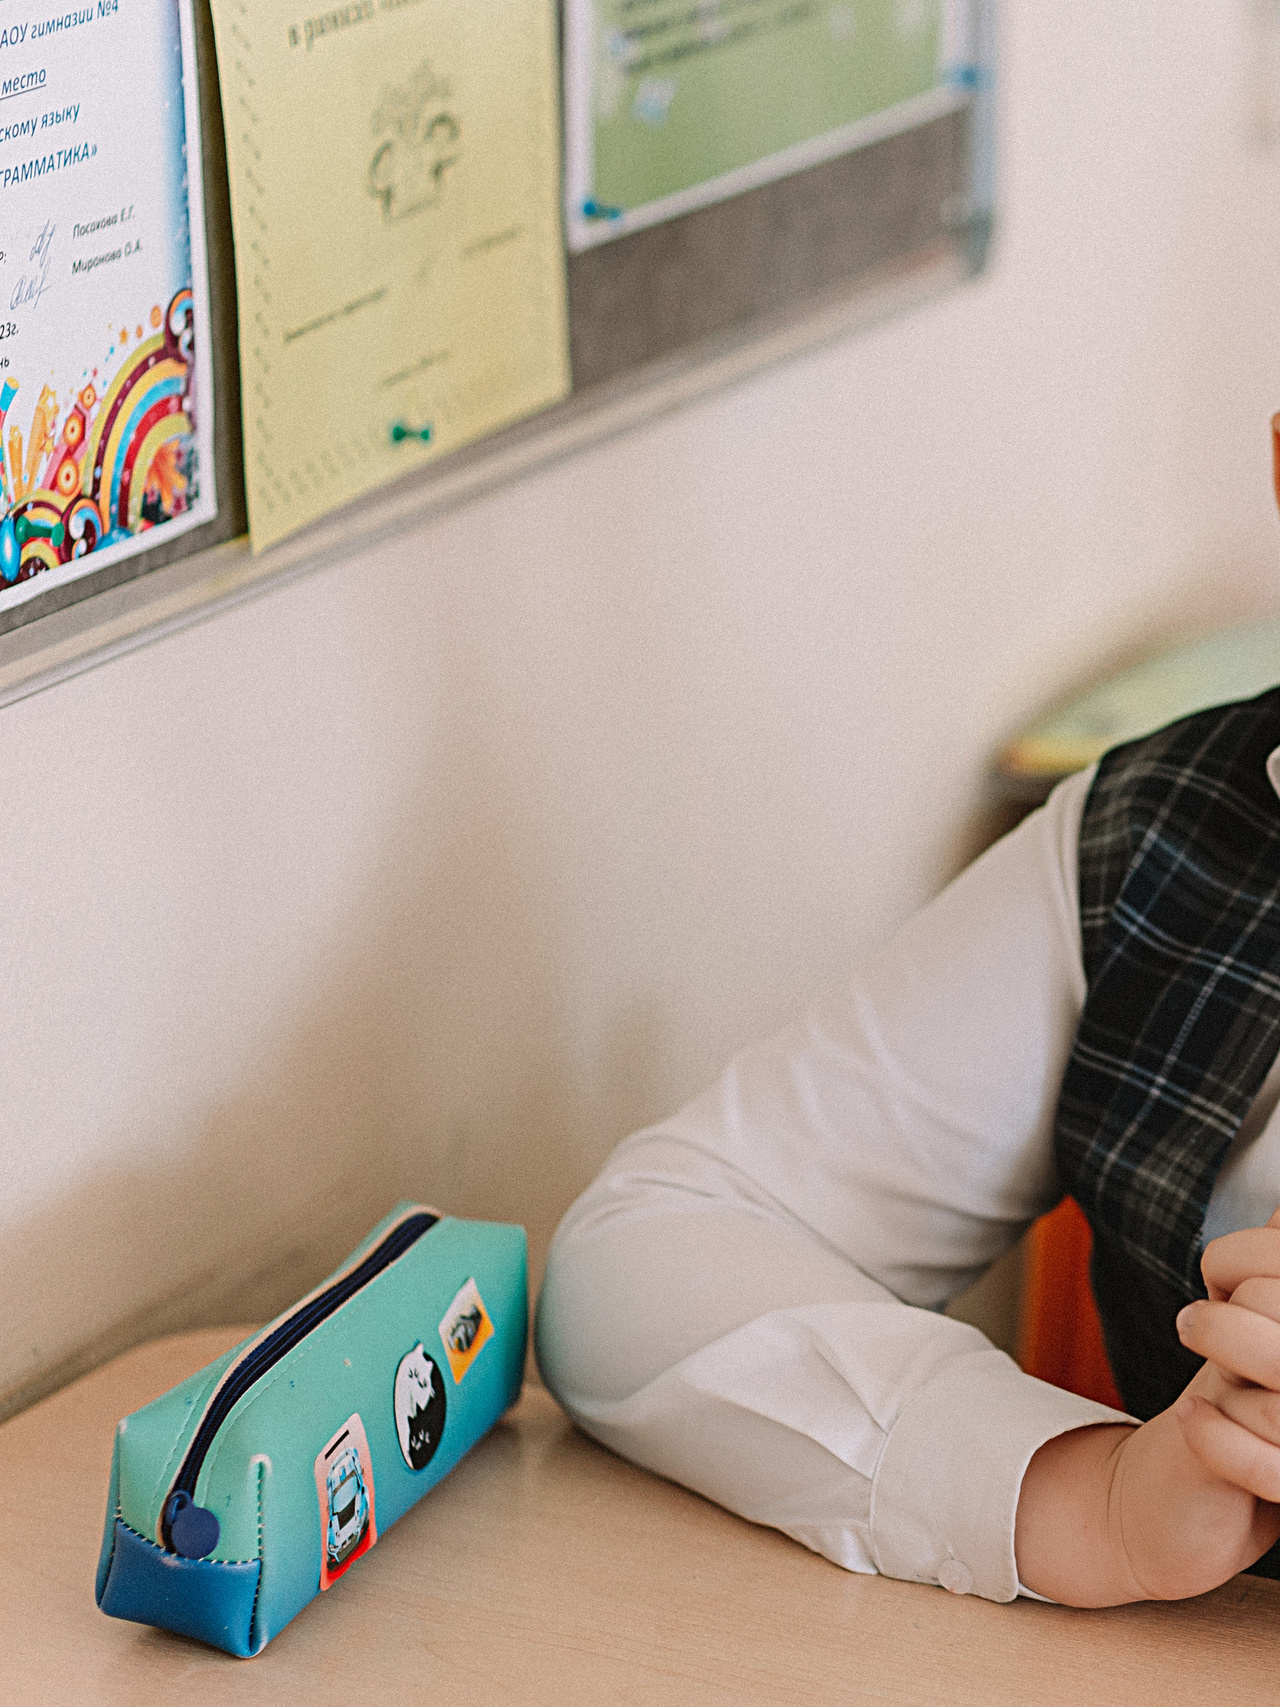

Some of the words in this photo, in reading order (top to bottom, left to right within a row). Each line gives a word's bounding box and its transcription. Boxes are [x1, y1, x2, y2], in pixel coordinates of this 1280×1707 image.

[31, 8, 94, 39] гимназии
[1, 68, 46, 96] место
[40, 103, 80, 129] языку
